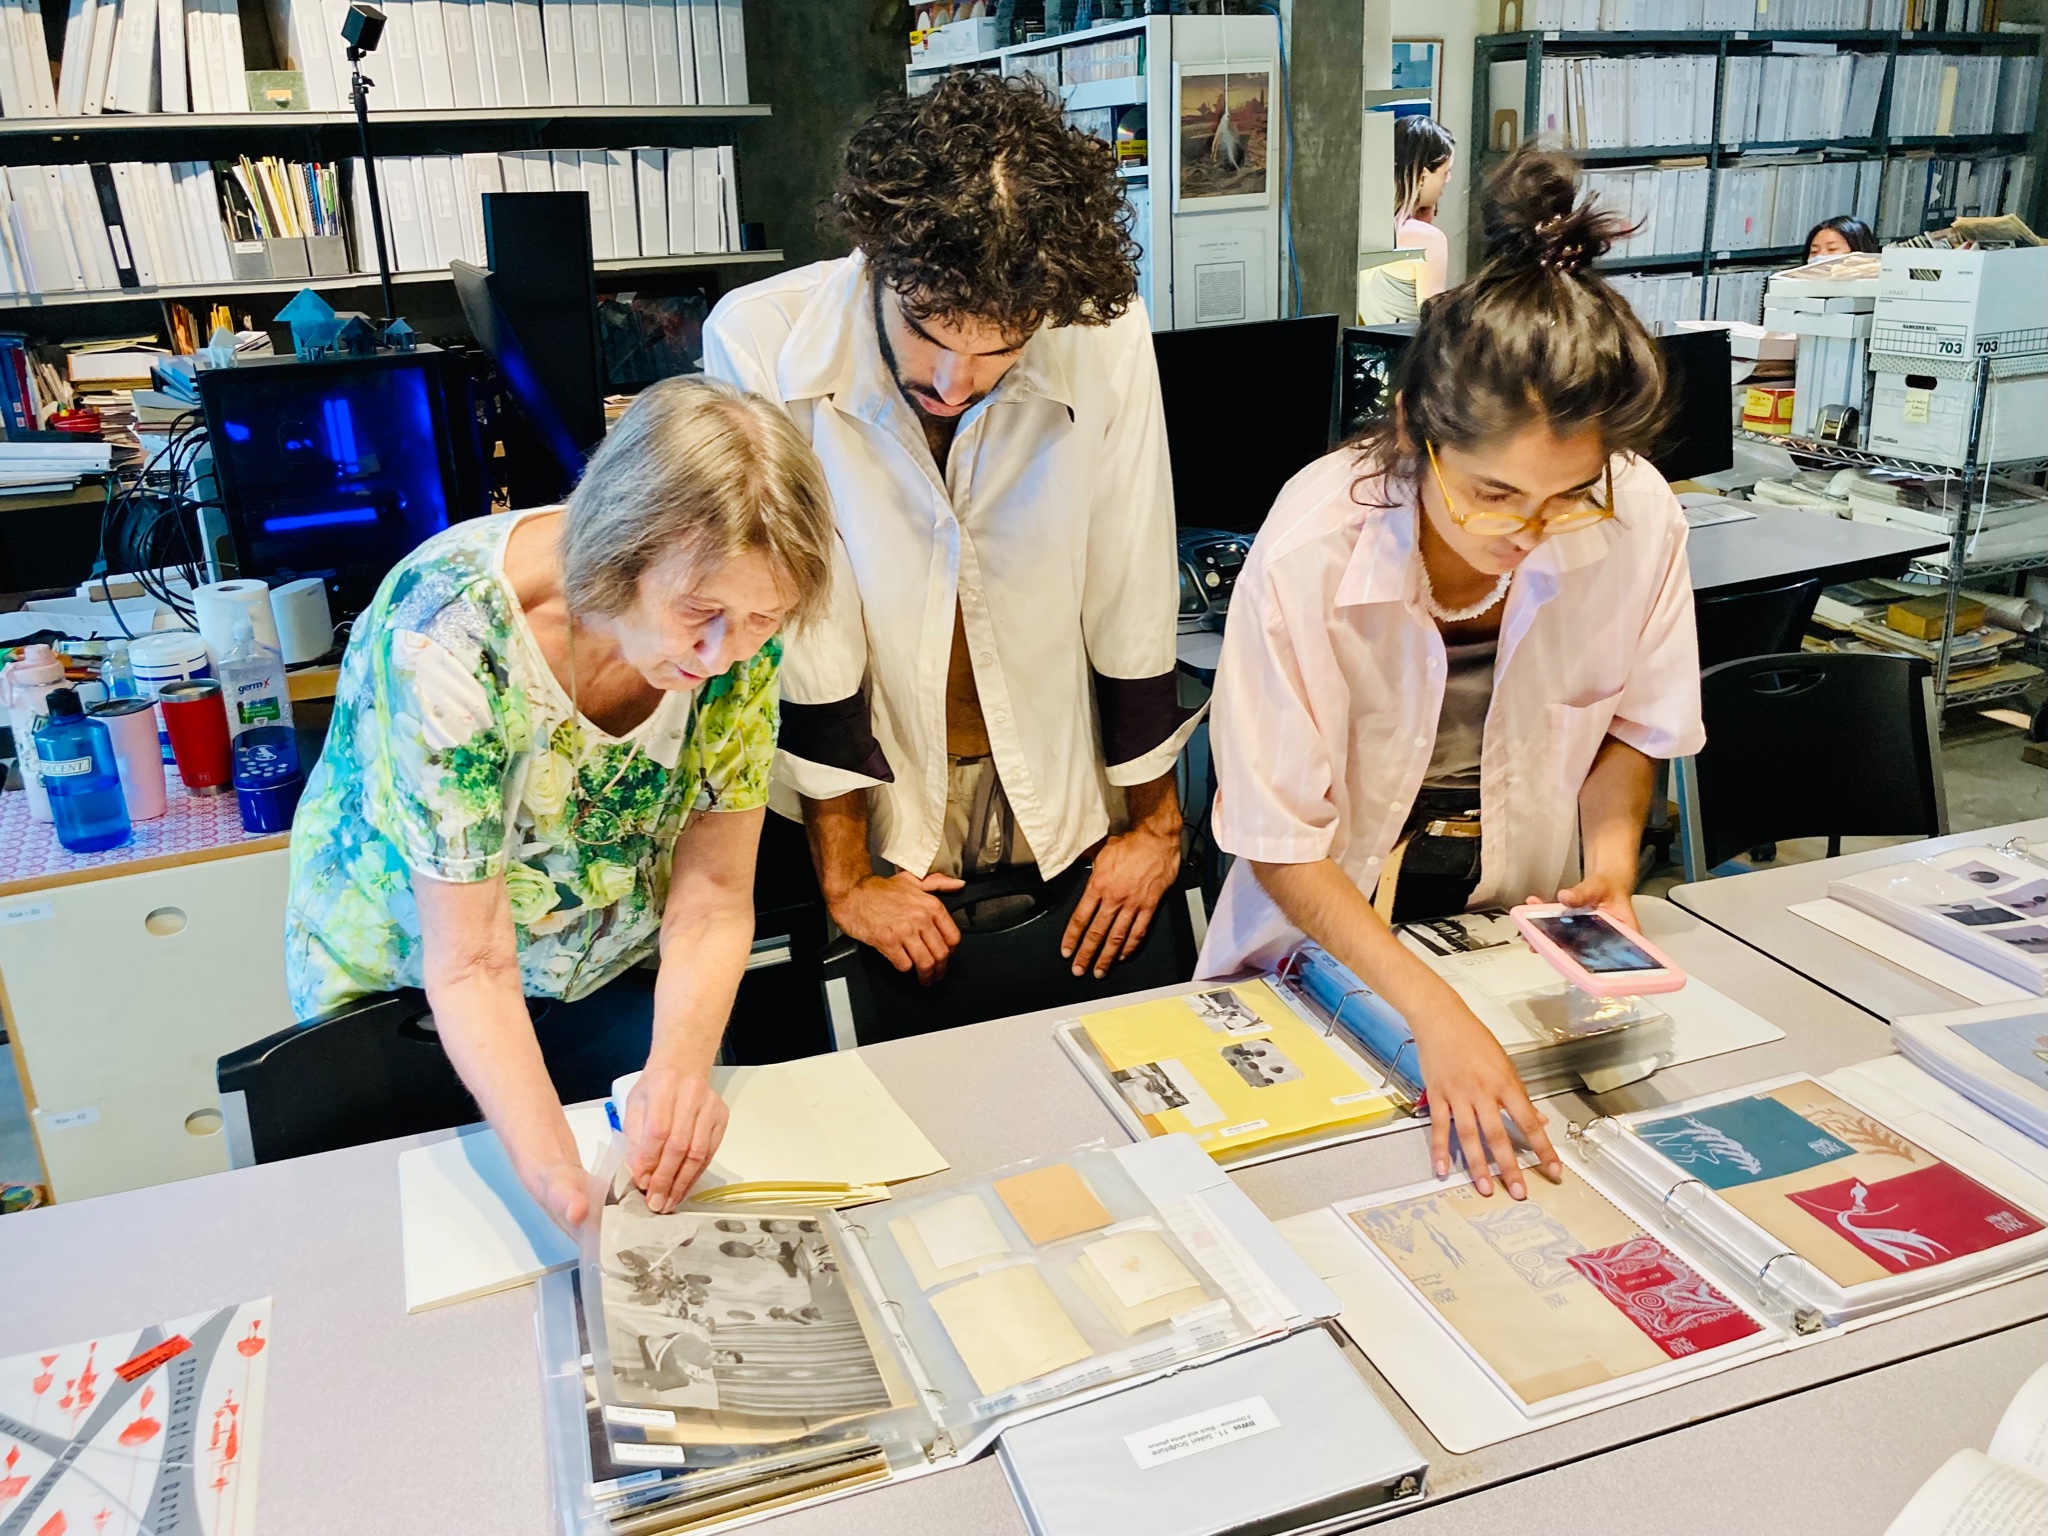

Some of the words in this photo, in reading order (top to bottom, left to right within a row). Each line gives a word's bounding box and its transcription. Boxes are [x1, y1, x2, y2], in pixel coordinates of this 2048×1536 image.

[1938, 341, 1963, 354] 703
[1976, 341, 1998, 354] 703
[173, 1358, 197, 1414] sounds
[169, 1421, 191, 1439] of
[1200, 1425, 1216, 1433] Black
[1233, 1420, 1256, 1431] BWss
[1170, 1434, 1187, 1442] white
[1187, 1430, 1199, 1438] and
[1191, 1433, 1214, 1445] Soleri
[1148, 1439, 1170, 1449] photos
[1151, 1440, 1190, 1456] Sculpture
[164, 1445, 188, 1474] the
[155, 1481, 181, 1535] earth
